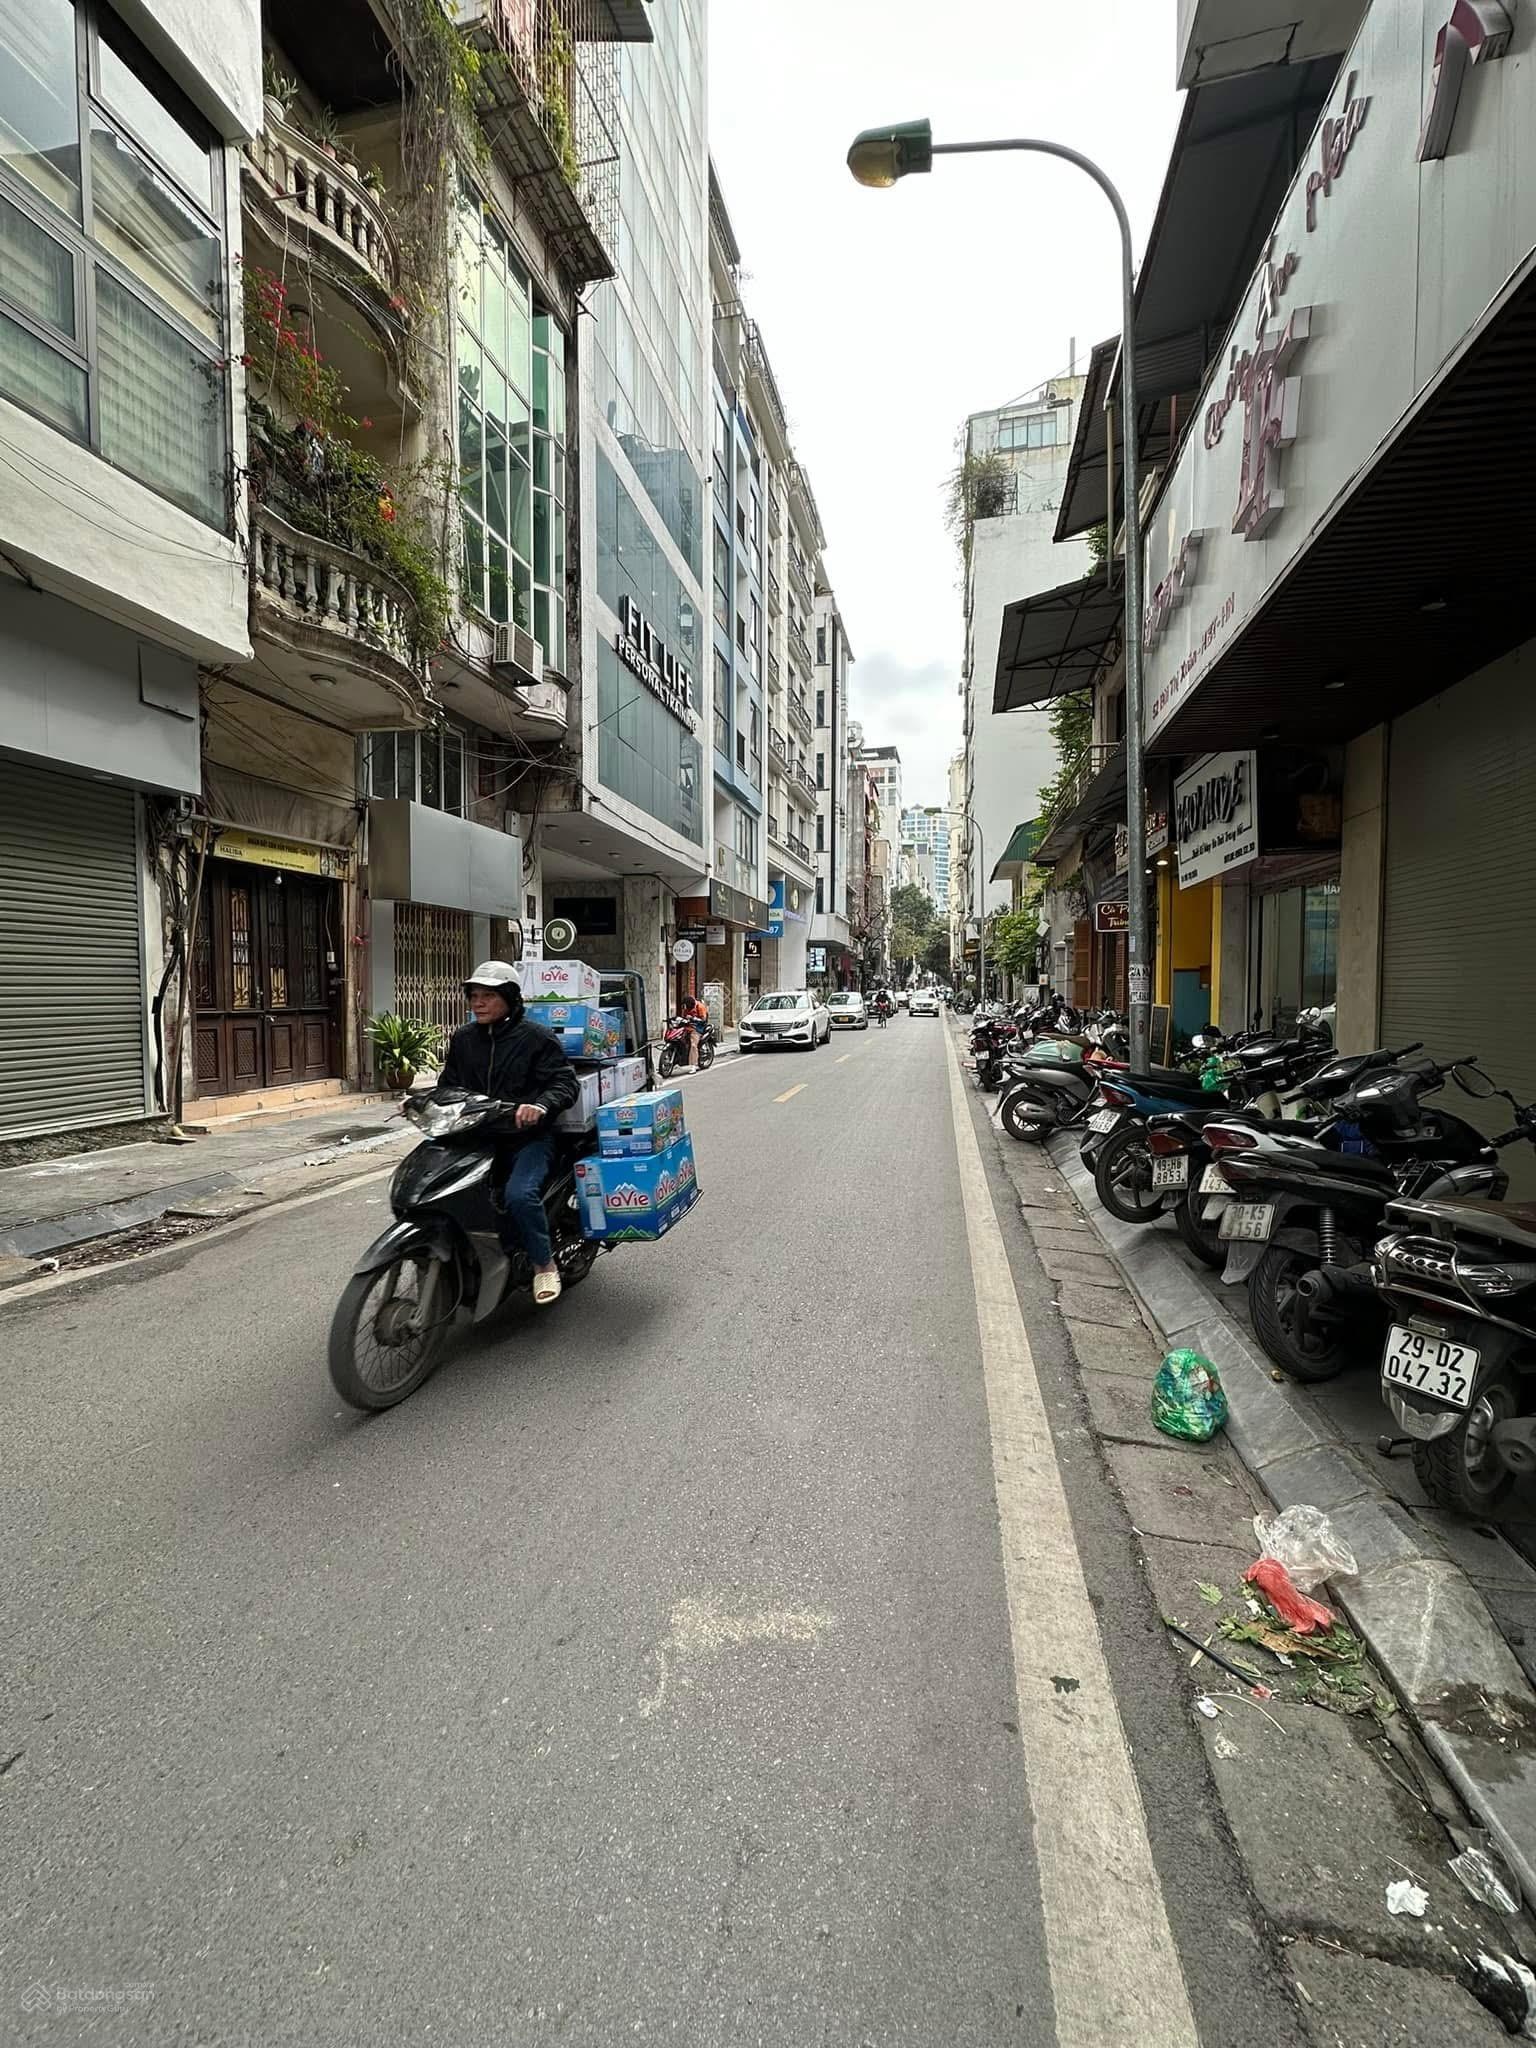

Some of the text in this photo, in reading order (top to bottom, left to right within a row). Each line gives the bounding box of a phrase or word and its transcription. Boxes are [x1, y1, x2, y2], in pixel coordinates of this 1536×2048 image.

[618, 634, 664, 703] PERSONAL
[625, 593, 695, 709] FIT LIFE
[541, 971, 569, 981] laVie
[605, 1190, 649, 1207] laVie
[656, 1179, 676, 1202] laVie
[1399, 1332, 1464, 1373] 29-D2
[1388, 1355, 1467, 1402] 047.32
